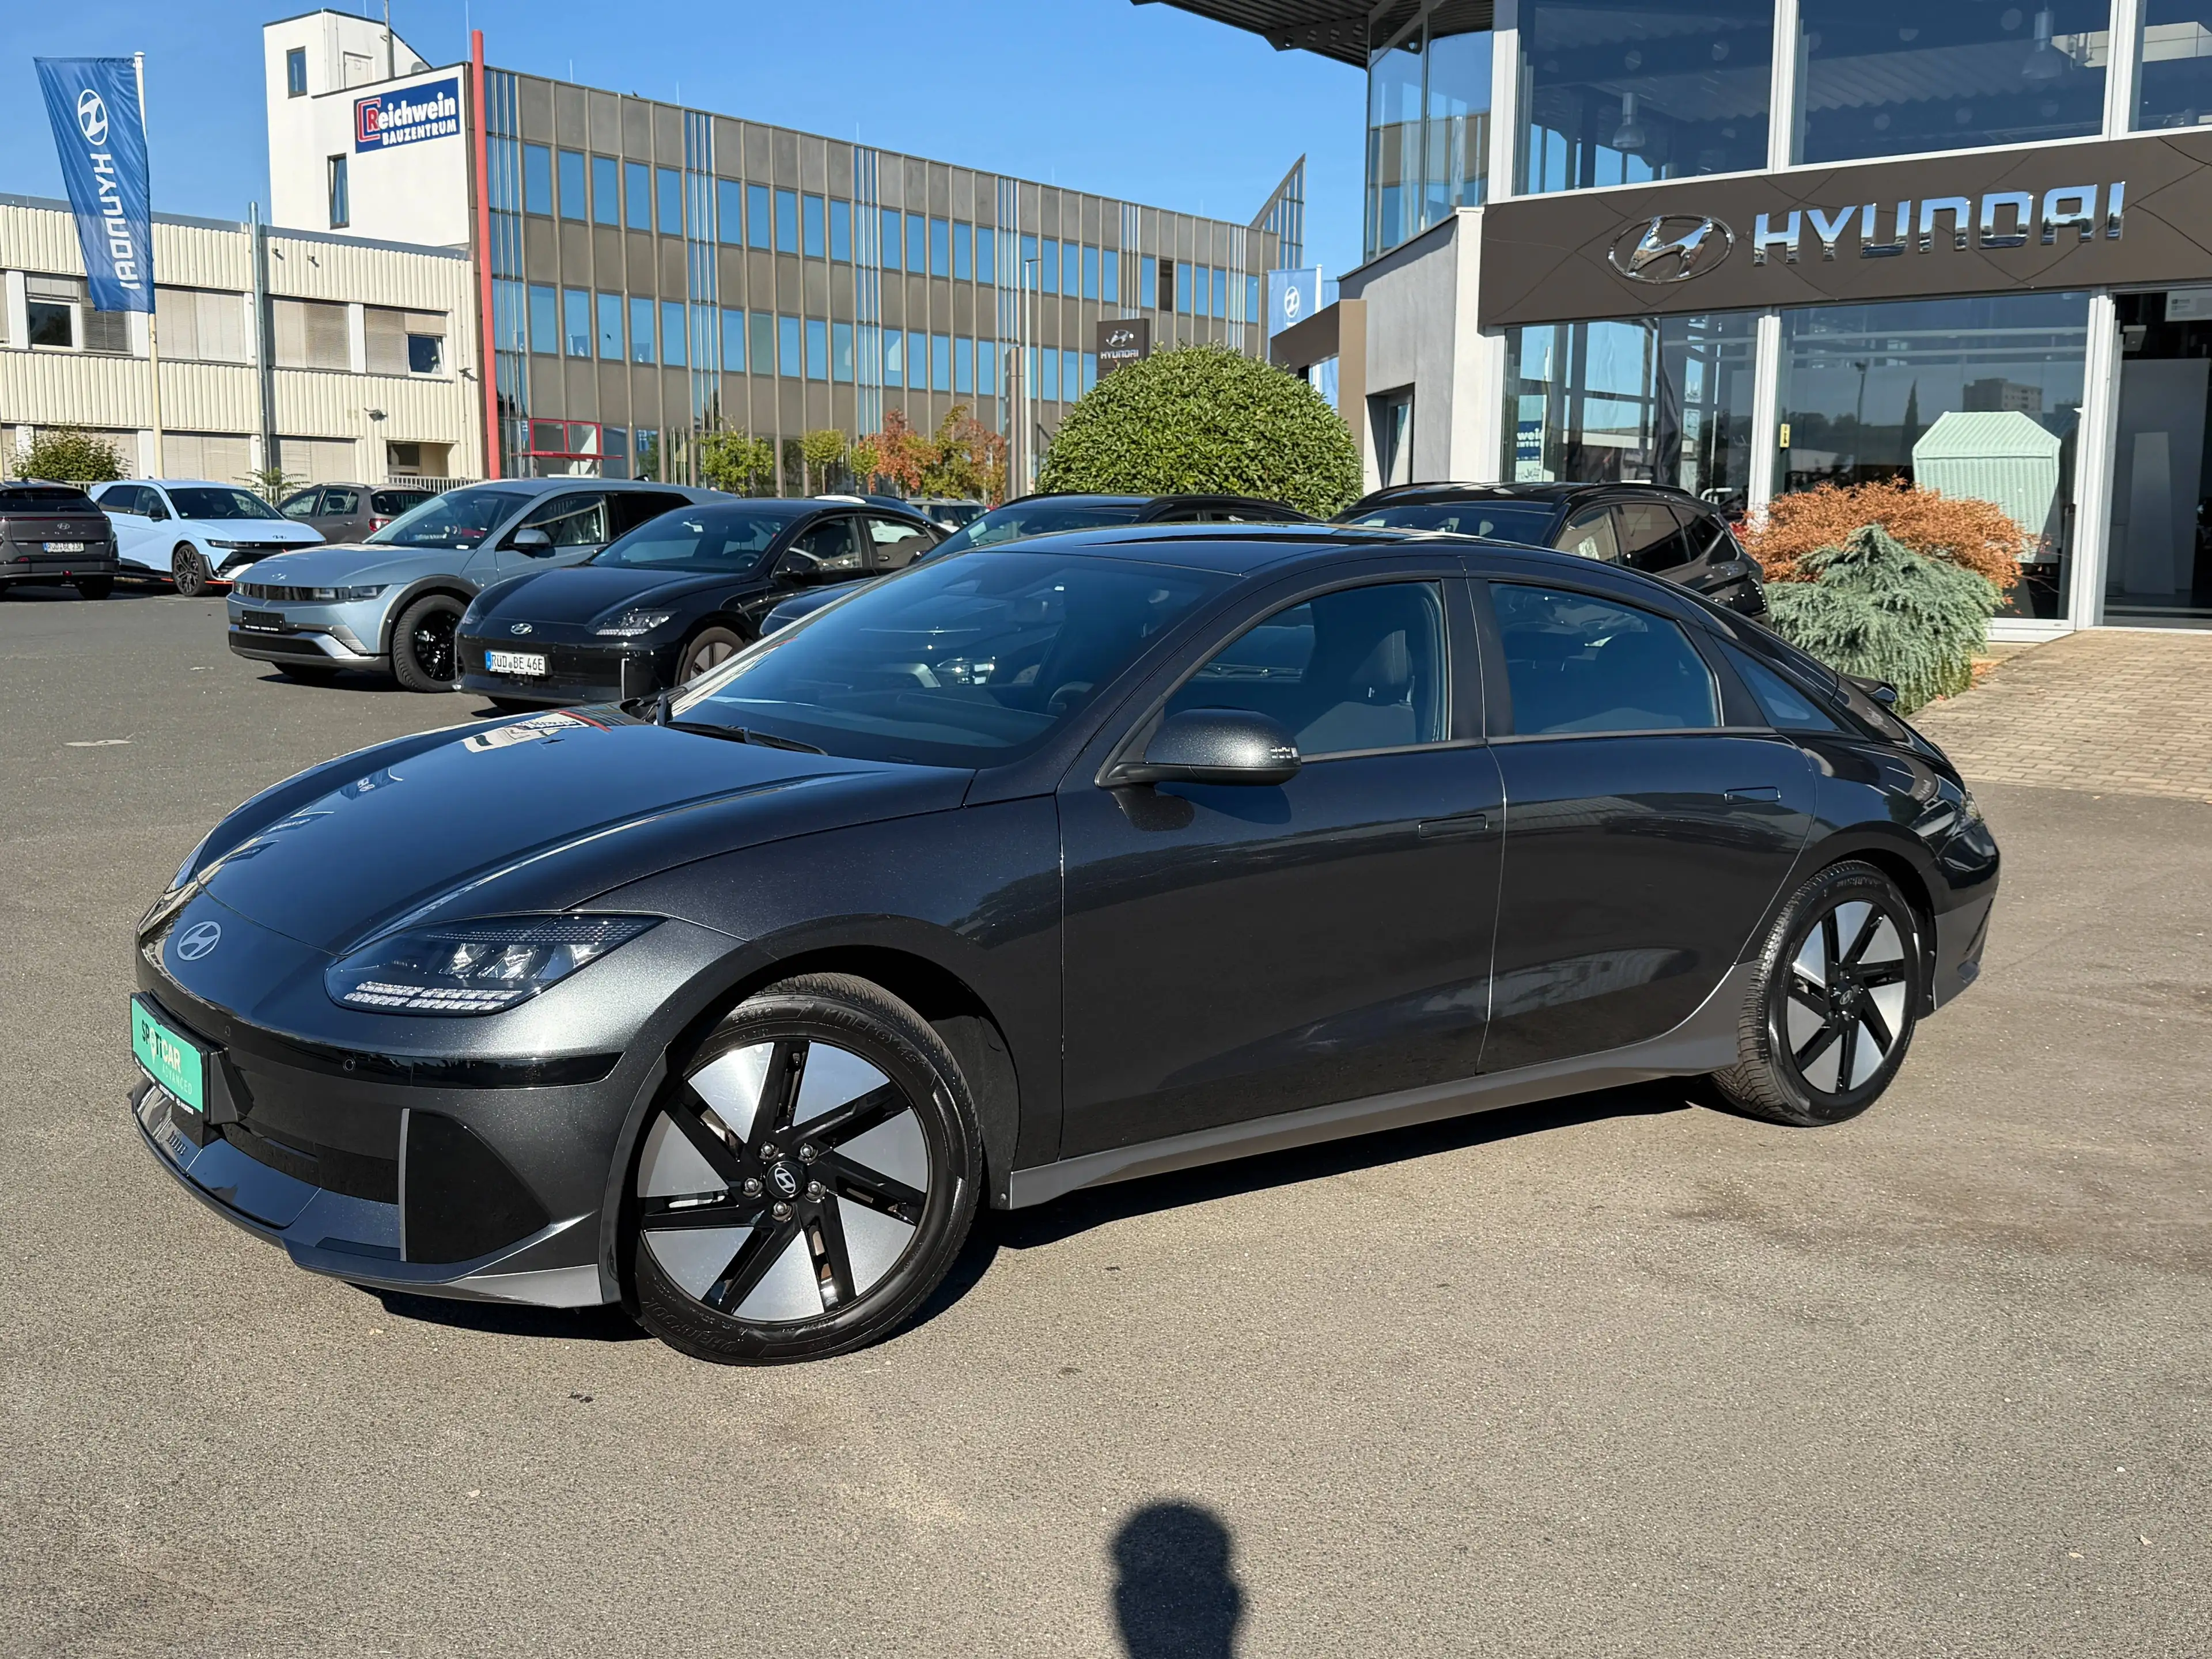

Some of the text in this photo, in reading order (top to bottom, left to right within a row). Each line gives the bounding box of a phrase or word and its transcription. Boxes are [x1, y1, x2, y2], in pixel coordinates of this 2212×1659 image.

[365, 91, 456, 133] Reichwein
[382, 119, 457, 146] BAUZENTRUM
[90, 153, 141, 290] HYUNDAI
[1752, 180, 2127, 267] HYUNDAI
[1100, 349, 1139, 359] HYUNDAI
[491, 654, 543, 671] RÜD BE 46E
[162, 1063, 192, 1095] ADVANCED
